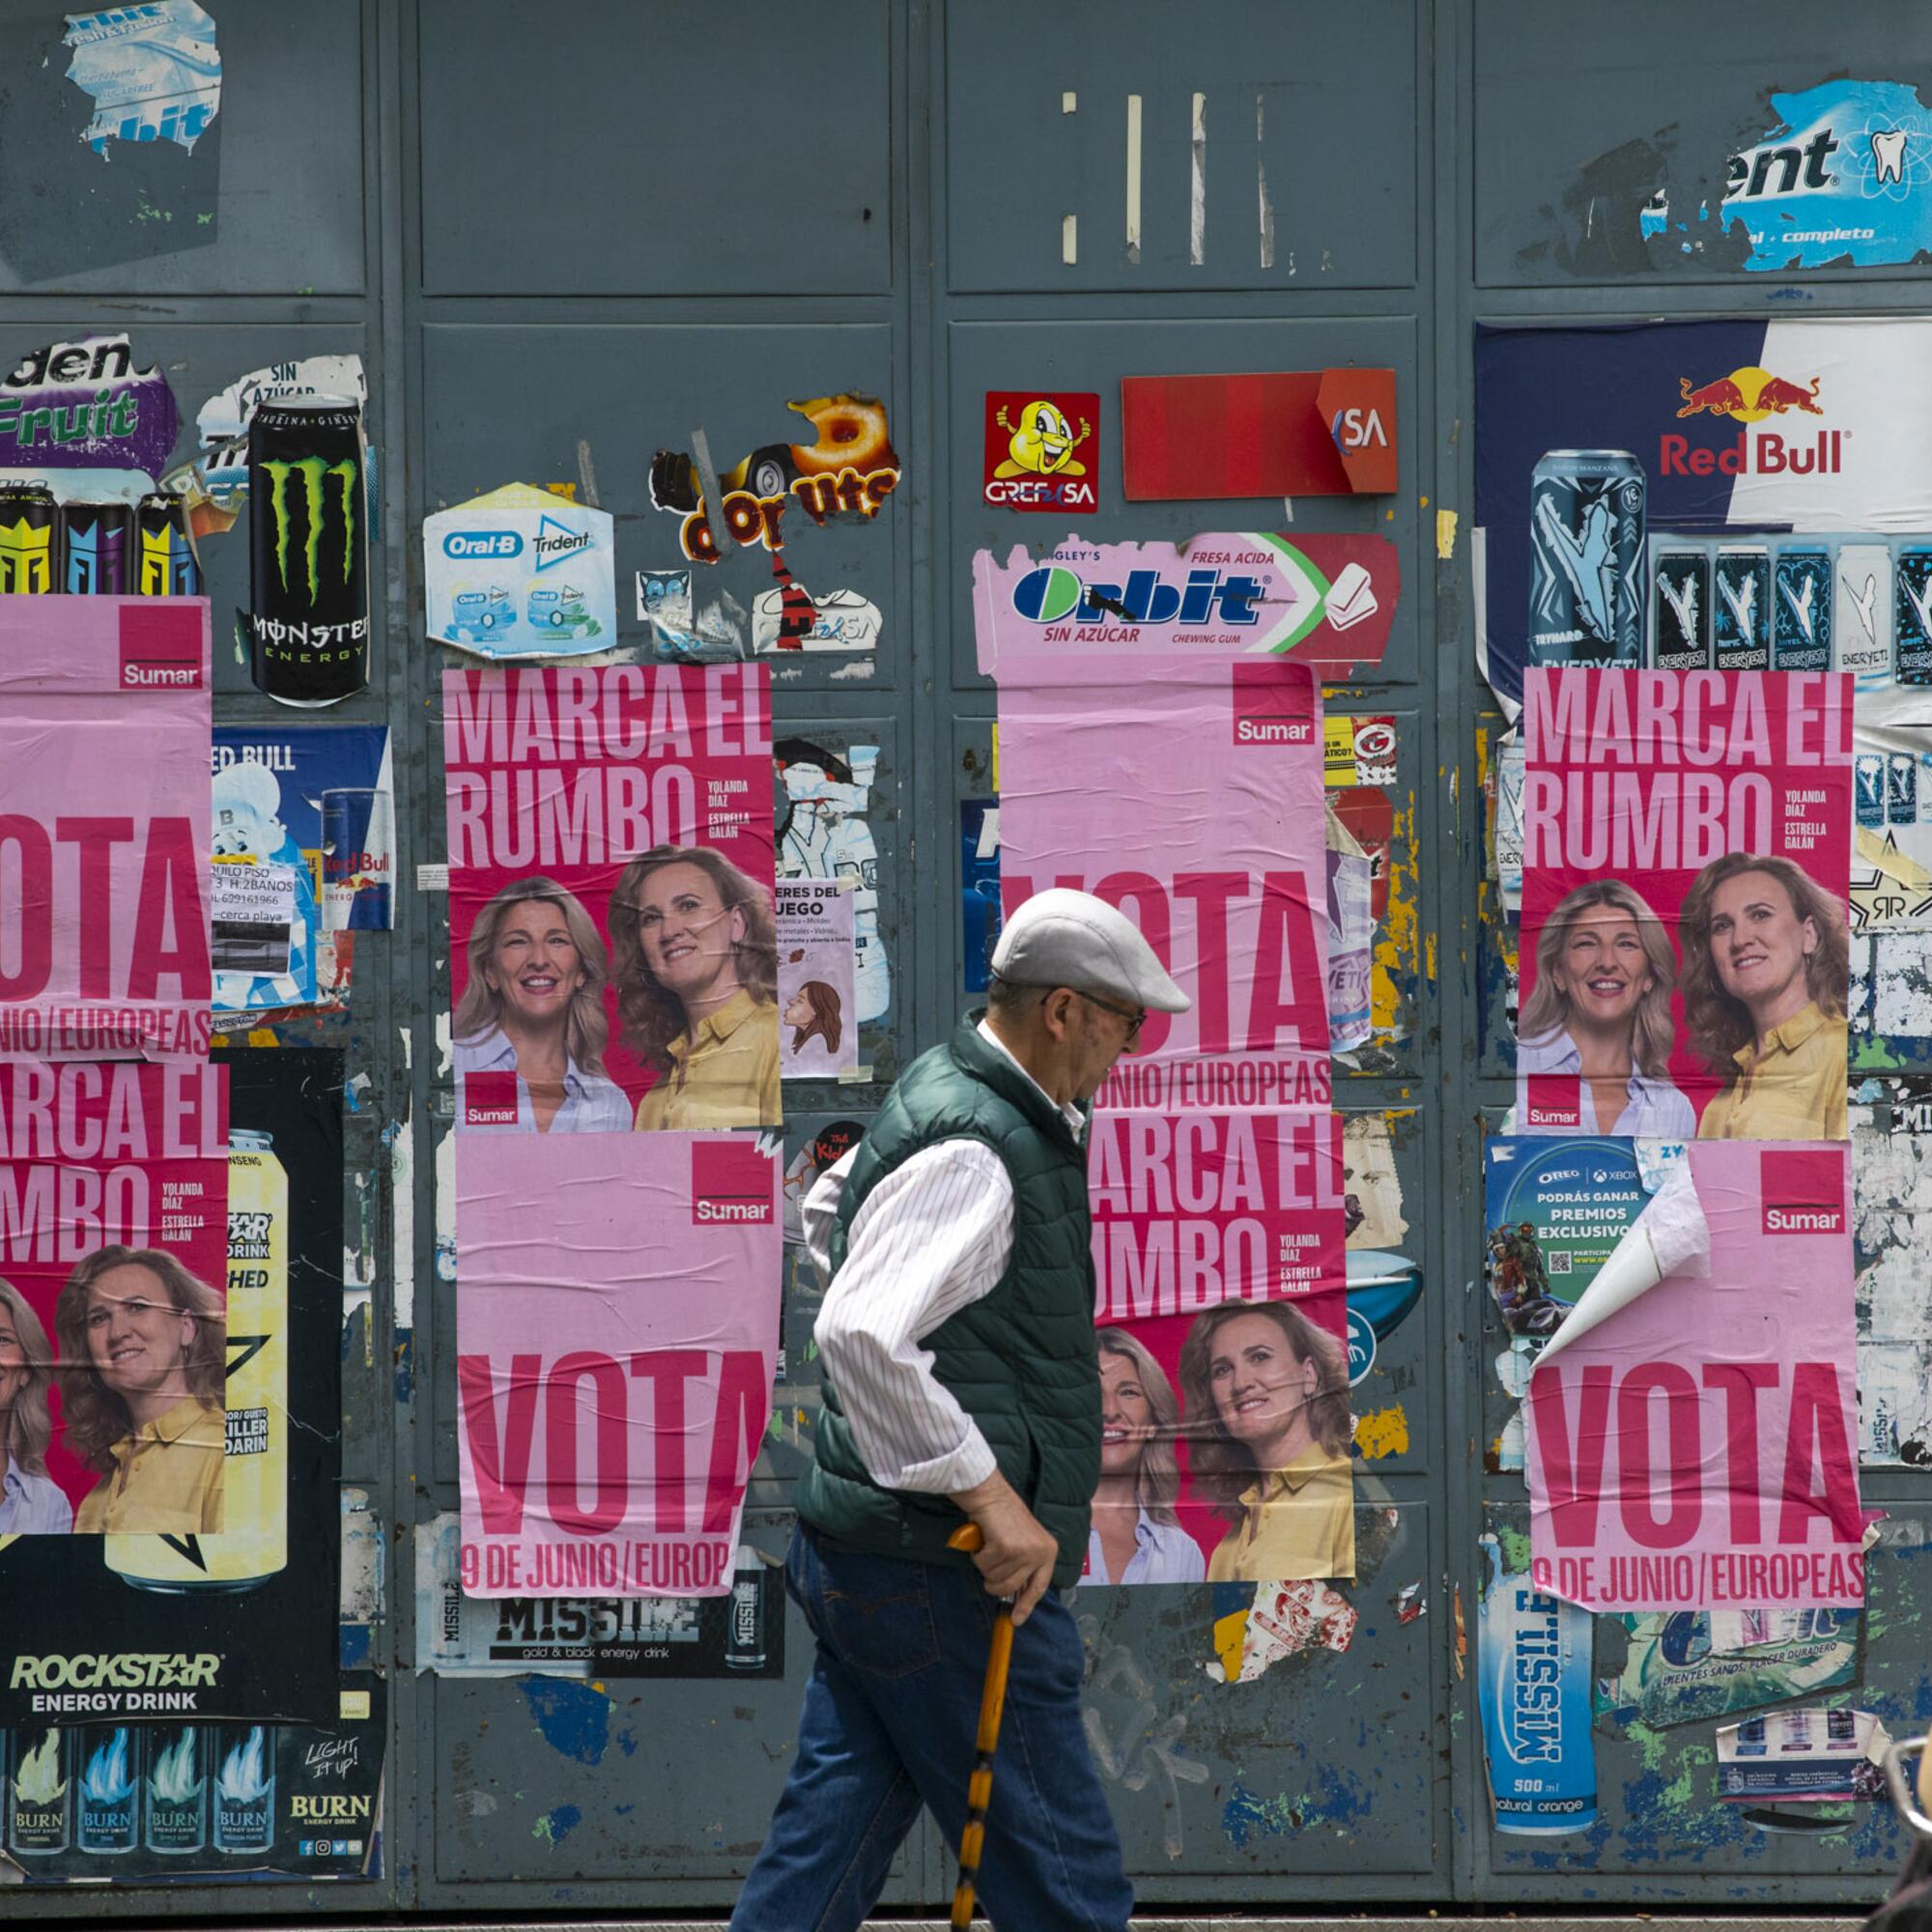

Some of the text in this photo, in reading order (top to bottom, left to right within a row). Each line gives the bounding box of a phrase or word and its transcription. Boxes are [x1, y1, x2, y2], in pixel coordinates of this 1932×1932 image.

[1781, 227, 1875, 244] completo
[270, 362, 298, 382] SIN
[1661, 430, 1841, 476] Red Bull
[448, 532, 590, 555] Oral-B Trident
[1190, 552, 1275, 565] FRESA ACIDA
[1043, 624, 1141, 642] SIN AZÚCAR
[1171, 634, 1241, 644] CHEWING GUM
[265, 644, 363, 664] ENERGY
[124, 664, 198, 686] Sumar
[442, 662, 773, 764] MARCA EL
[1523, 667, 1854, 767] MARCA EL
[1237, 720, 1310, 742] Sumar
[242, 745, 297, 771] BULL
[708, 780, 749, 794] YOLANDA
[1785, 789, 1827, 804] YOLANDA
[446, 764, 696, 869] RUMBO
[1785, 802, 1805, 817] DÍAZ
[708, 812, 751, 826] ESTRELLA
[1523, 770, 1773, 869] RUMBO
[1784, 822, 1827, 836] ESTRELLA
[1784, 833, 1815, 849] GALÁN
[359, 852, 390, 872] Bull
[244, 867, 270, 879] PISO
[215, 877, 223, 890] 3
[814, 887, 840, 897] DEL
[253, 910, 283, 924] playa
[63, 1009, 212, 1056] EUROPEAS
[1180, 1059, 1331, 1108] EUROPEAS
[162, 1063, 230, 1159] EL
[467, 1109, 516, 1123] Sumar
[1529, 1109, 1577, 1123] Sumar
[1277, 1114, 1346, 1211] EL
[1538, 1169, 1638, 1184] OREO XBOX
[162, 1182, 205, 1197] YOLANDA
[1537, 1190, 1640, 1204] PODRÁS GANAR
[696, 1200, 770, 1221] Sumar
[1550, 1208, 1628, 1222] PREMIOS
[161, 1214, 205, 1229] ESTRELLA
[1767, 1209, 1840, 1231] Sumar
[1279, 1235, 1321, 1248] YOLANDA
[228, 1269, 269, 1289] HED
[1280, 1266, 1322, 1280] ESTRELLA
[457, 1350, 767, 1537] VOTA
[1529, 1361, 1862, 1549] VOTA
[461, 1541, 729, 1590] 9 DE JUNIO EUROP
[1559, 1555, 1596, 1604] DE
[1600, 1553, 1694, 1604] JUNIO
[1711, 1551, 1864, 1602] EUROPEAS
[522, 1647, 549, 1659] gold
[551, 1648, 562, 1658] &
[601, 1648, 639, 1660] energy
[644, 1647, 670, 1658] drink
[1787, 1642, 1837, 1661] DURADERO
[9, 1653, 221, 1690] ROCKSTAR
[32, 1691, 198, 1713] ENERGY DRINK
[304, 1736, 360, 1766] LIGHT
[1514, 1778, 1544, 1794] 500
[290, 1795, 372, 1818] BURN
[1537, 1800, 1584, 1813] orange
[15, 1812, 64, 1828] BURN
[84, 1812, 131, 1827] BURN
[152, 1811, 199, 1827] BURN
[220, 1811, 268, 1827] BURN
